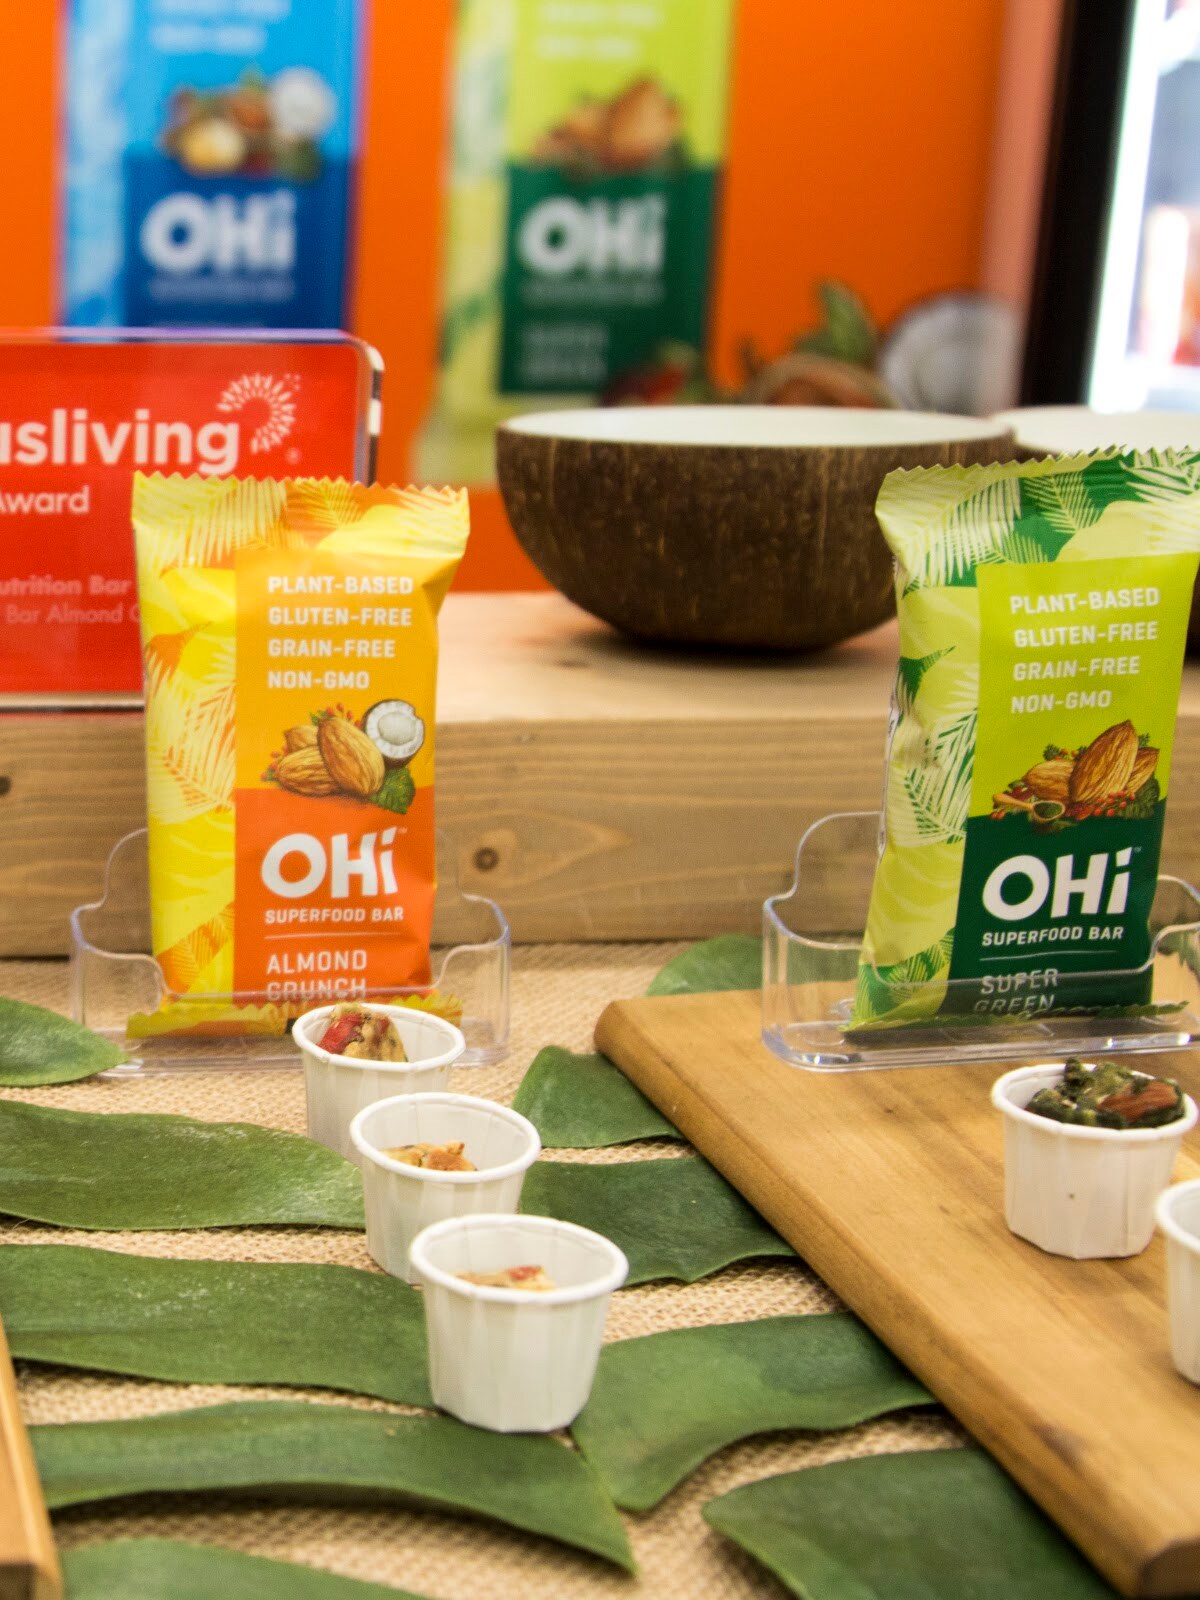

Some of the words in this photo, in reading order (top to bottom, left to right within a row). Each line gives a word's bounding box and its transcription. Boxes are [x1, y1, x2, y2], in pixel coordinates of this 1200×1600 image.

[139, 189, 297, 274] OHi
[519, 194, 667, 274] OHi
[88, 575, 131, 594] Bar
[268, 576, 413, 594] PLANT-BASED
[1010, 587, 1160, 615] PLANT-BASED
[6, 604, 40, 624] Bar
[46, 603, 123, 623] Almond
[268, 607, 412, 626] GLUTEN-FREE
[1014, 621, 1158, 648] GLUTEN-FREE
[268, 639, 395, 658] GRAIN-FREE
[267, 671, 370, 689] NON-GMO
[1013, 656, 1140, 681] GRAIN-FREE
[1011, 690, 1112, 714] NON-GMO
[261, 826, 398, 898] OHi
[982, 847, 1132, 921] OHi
[265, 908, 365, 924] SUPERFOOD
[372, 907, 404, 921] BAR
[982, 927, 1083, 946] SUPERFOOD
[1088, 926, 1124, 940] BAR
[266, 950, 367, 974] ALMOND
[981, 968, 1058, 994] SUPER
